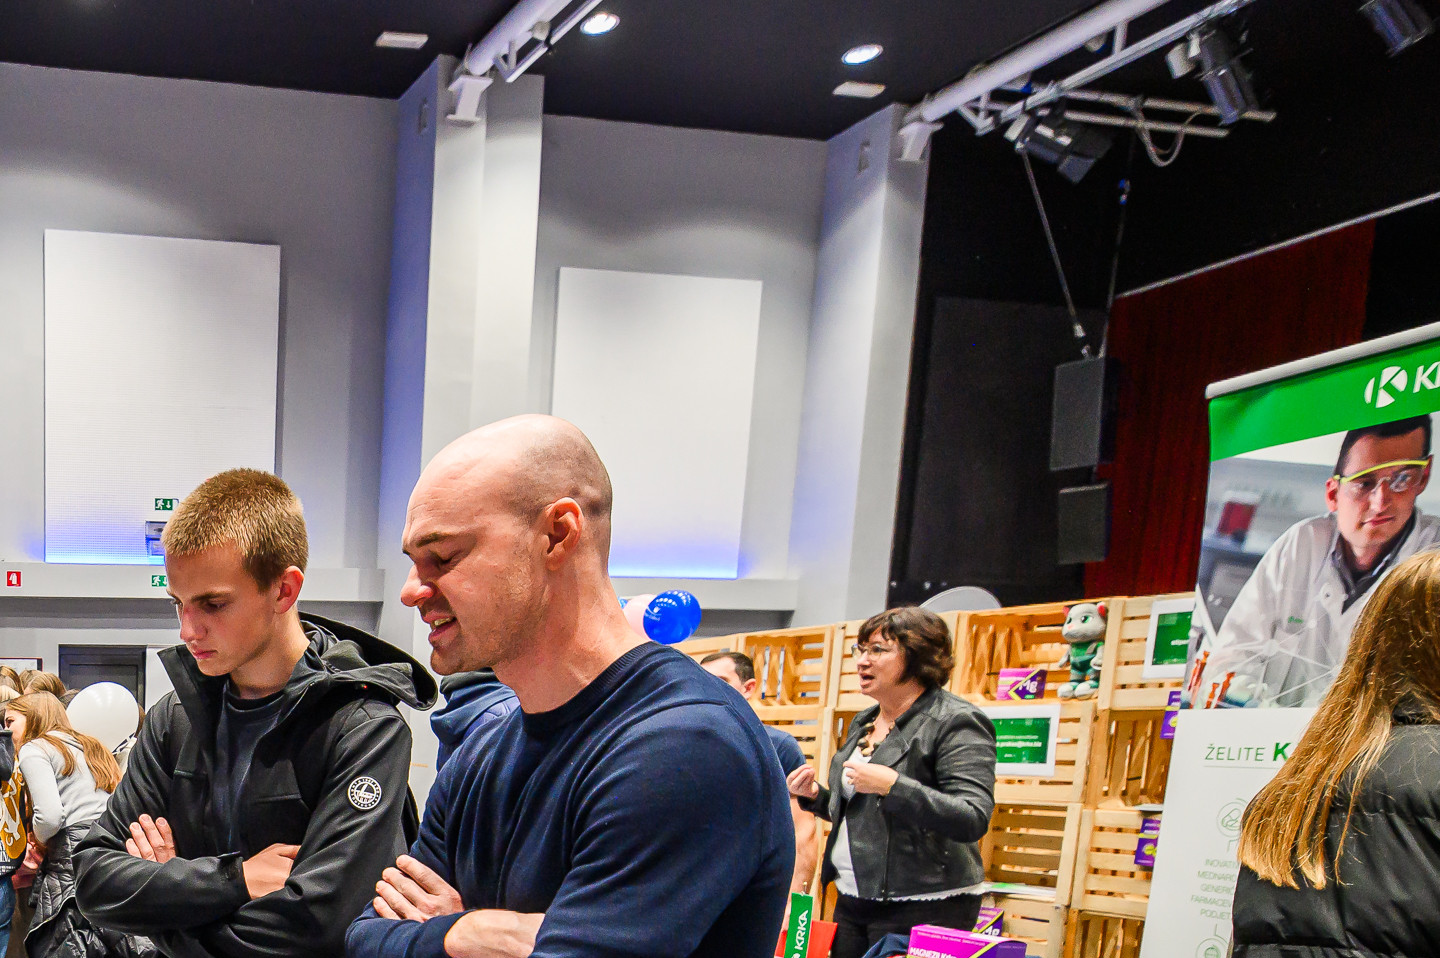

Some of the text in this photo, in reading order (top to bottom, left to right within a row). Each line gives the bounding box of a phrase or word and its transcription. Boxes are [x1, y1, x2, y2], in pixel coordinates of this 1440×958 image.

[1413, 360, 1440, 394] K
[1205, 743, 1266, 762] ŽELITE
[794, 909, 809, 951] KRKA
